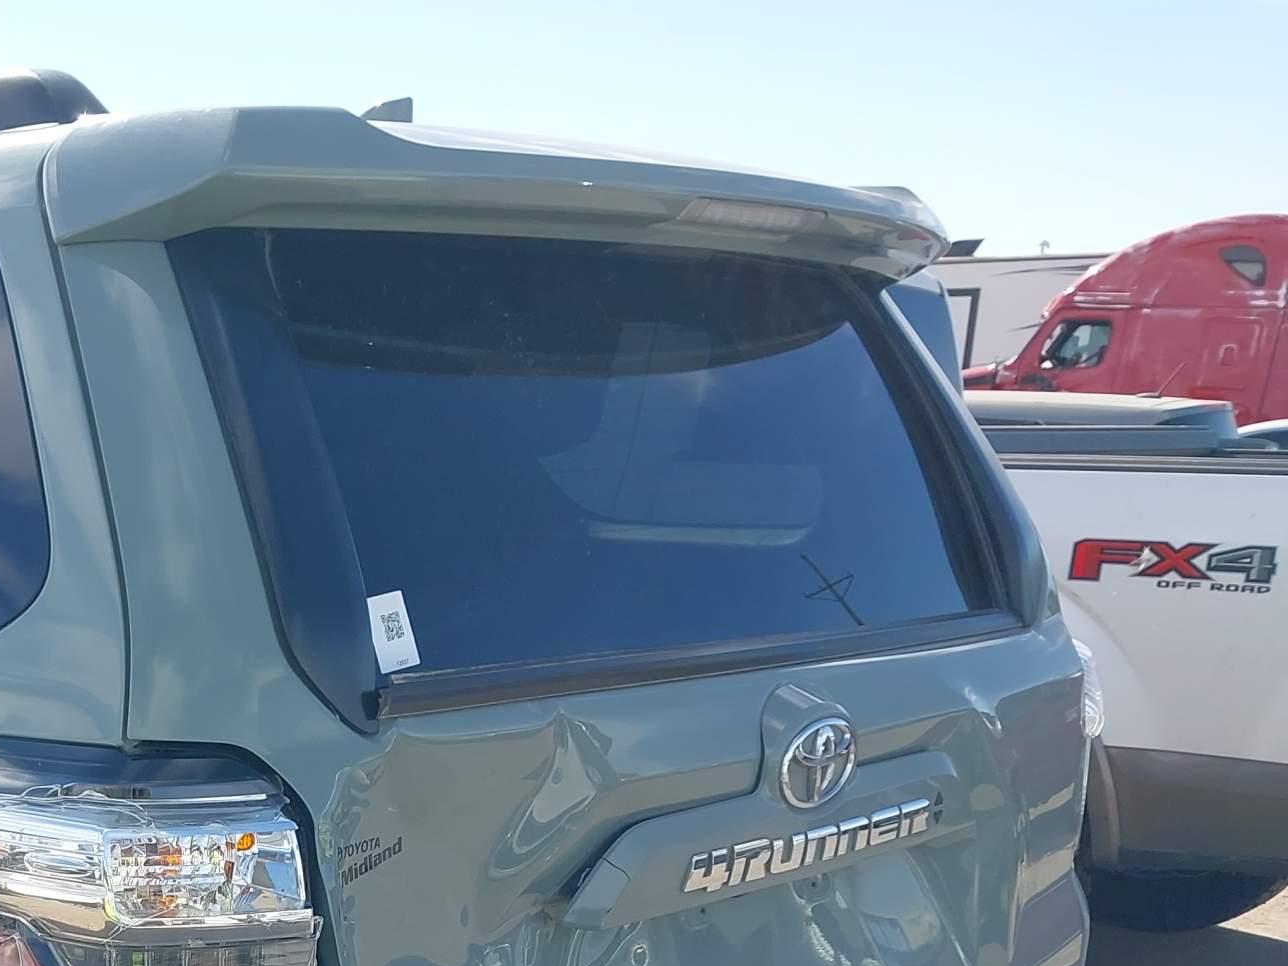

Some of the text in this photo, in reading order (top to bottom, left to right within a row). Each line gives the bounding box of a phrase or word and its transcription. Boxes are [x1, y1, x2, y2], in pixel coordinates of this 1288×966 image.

[1068, 538, 1278, 584] FX4
[1156, 579, 1272, 594] OFF ROAD
[339, 835, 403, 888] Midland
[343, 836, 381, 859] TOYOTA
[683, 796, 932, 895] 4RUNNER
